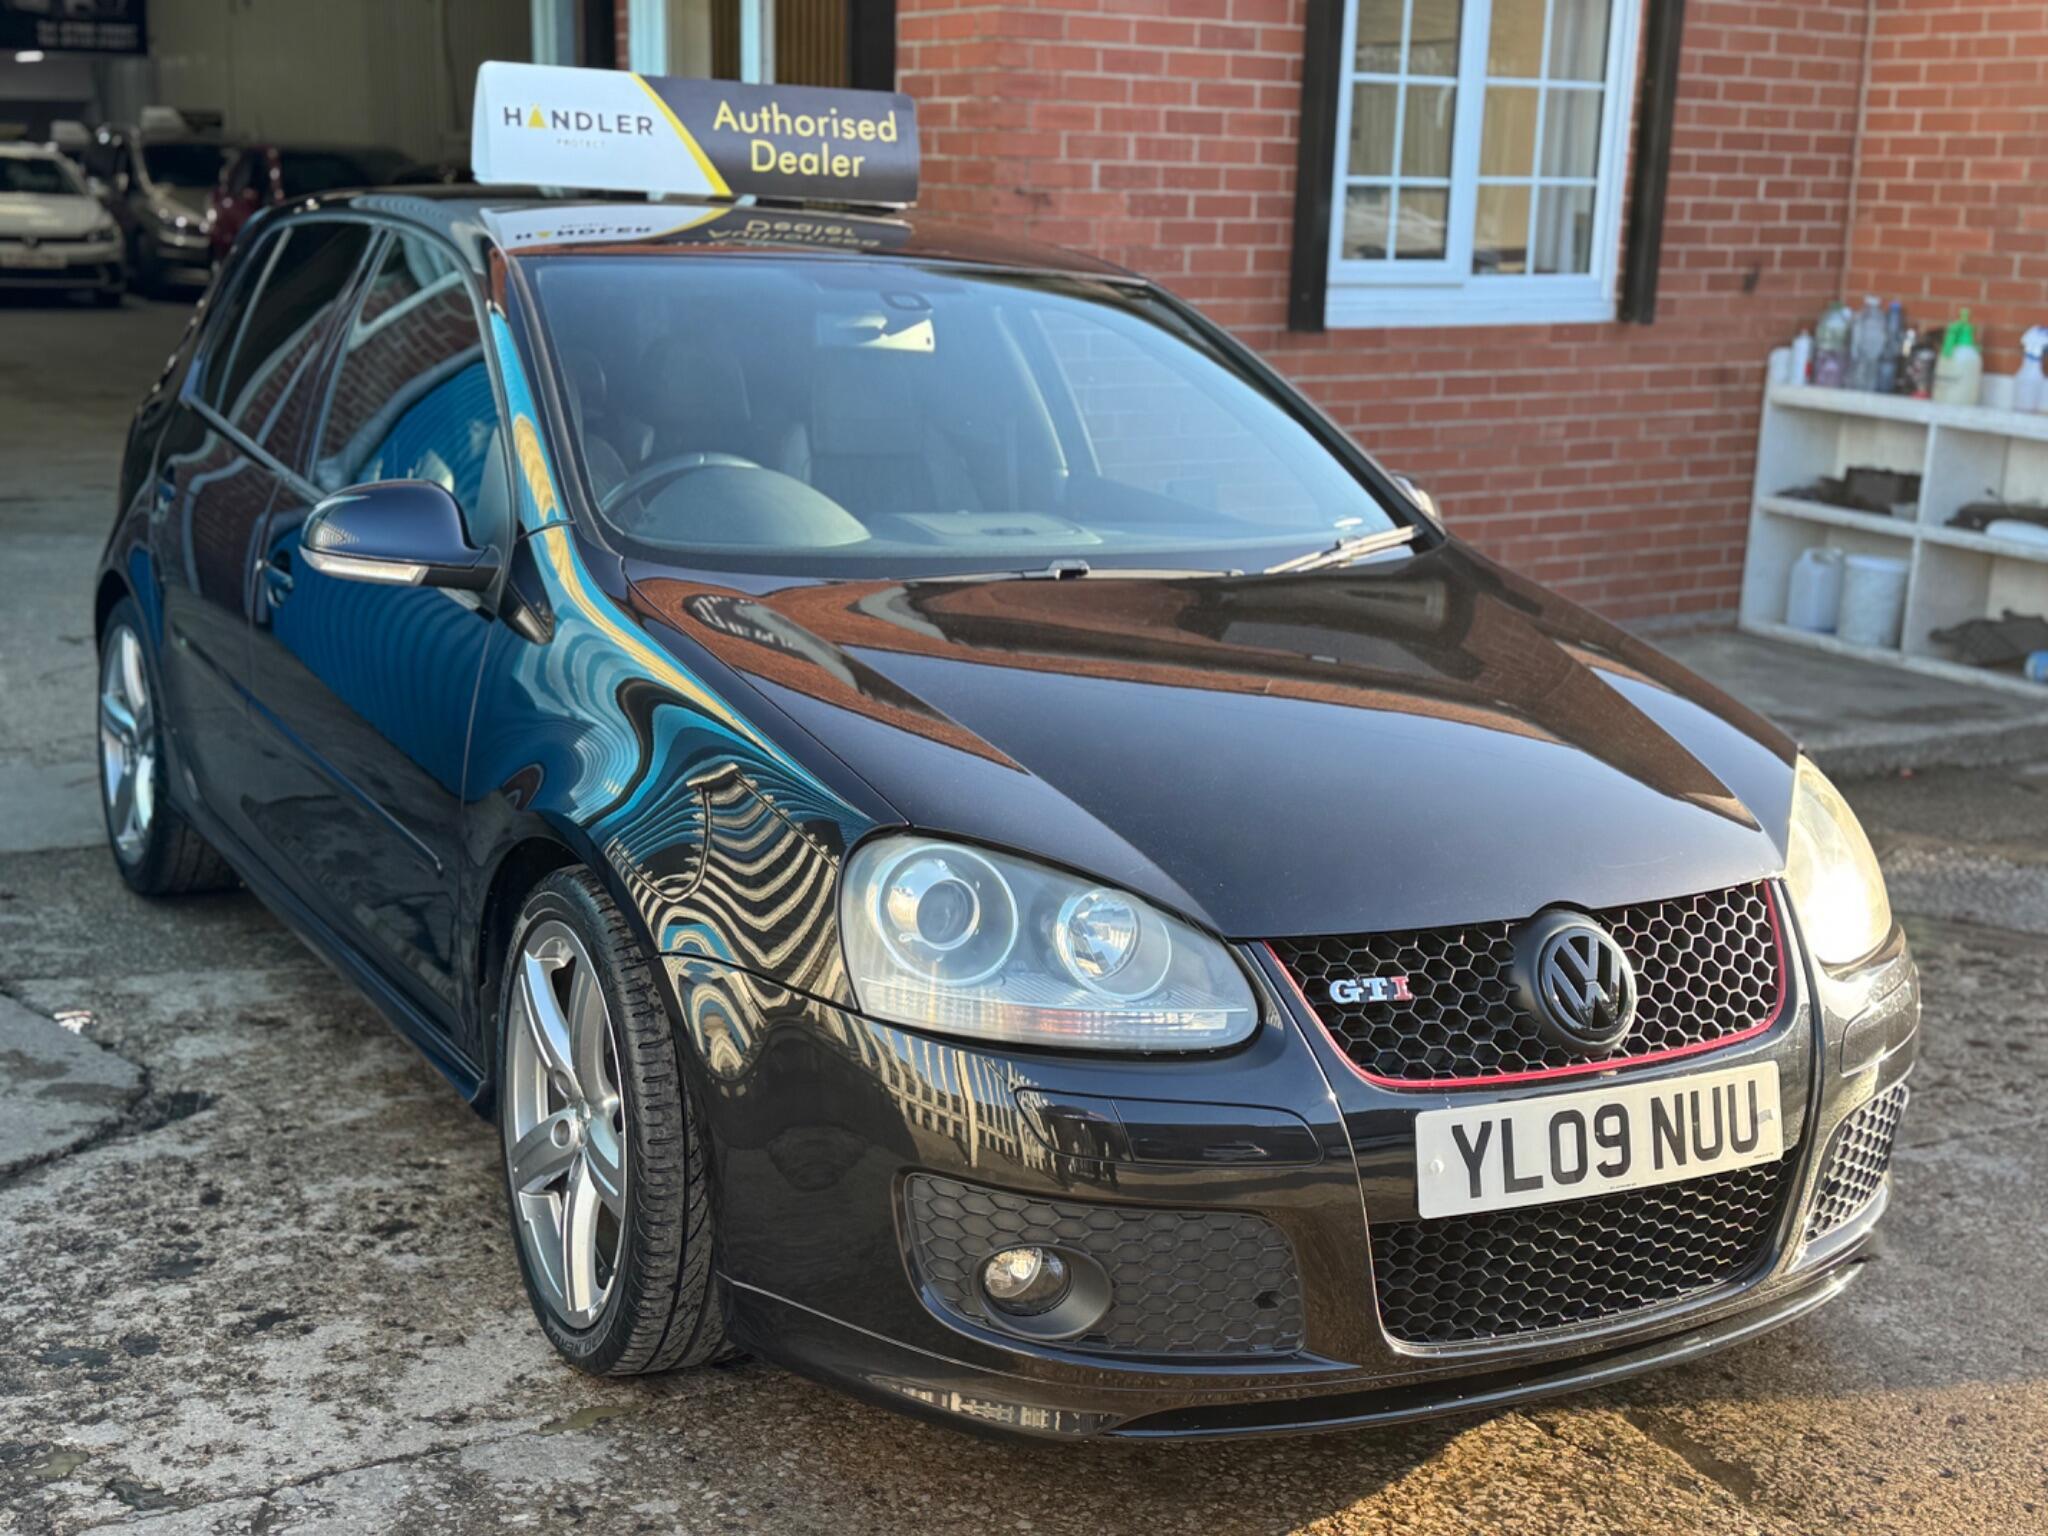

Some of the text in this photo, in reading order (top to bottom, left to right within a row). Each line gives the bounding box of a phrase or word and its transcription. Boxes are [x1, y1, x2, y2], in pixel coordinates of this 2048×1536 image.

[504, 106, 653, 136] HANDLER
[713, 100, 898, 142] Authorised
[751, 139, 865, 178] Dealer
[1328, 975, 1414, 1005] GTI
[1451, 1079, 1759, 1199] YL09 NUU
